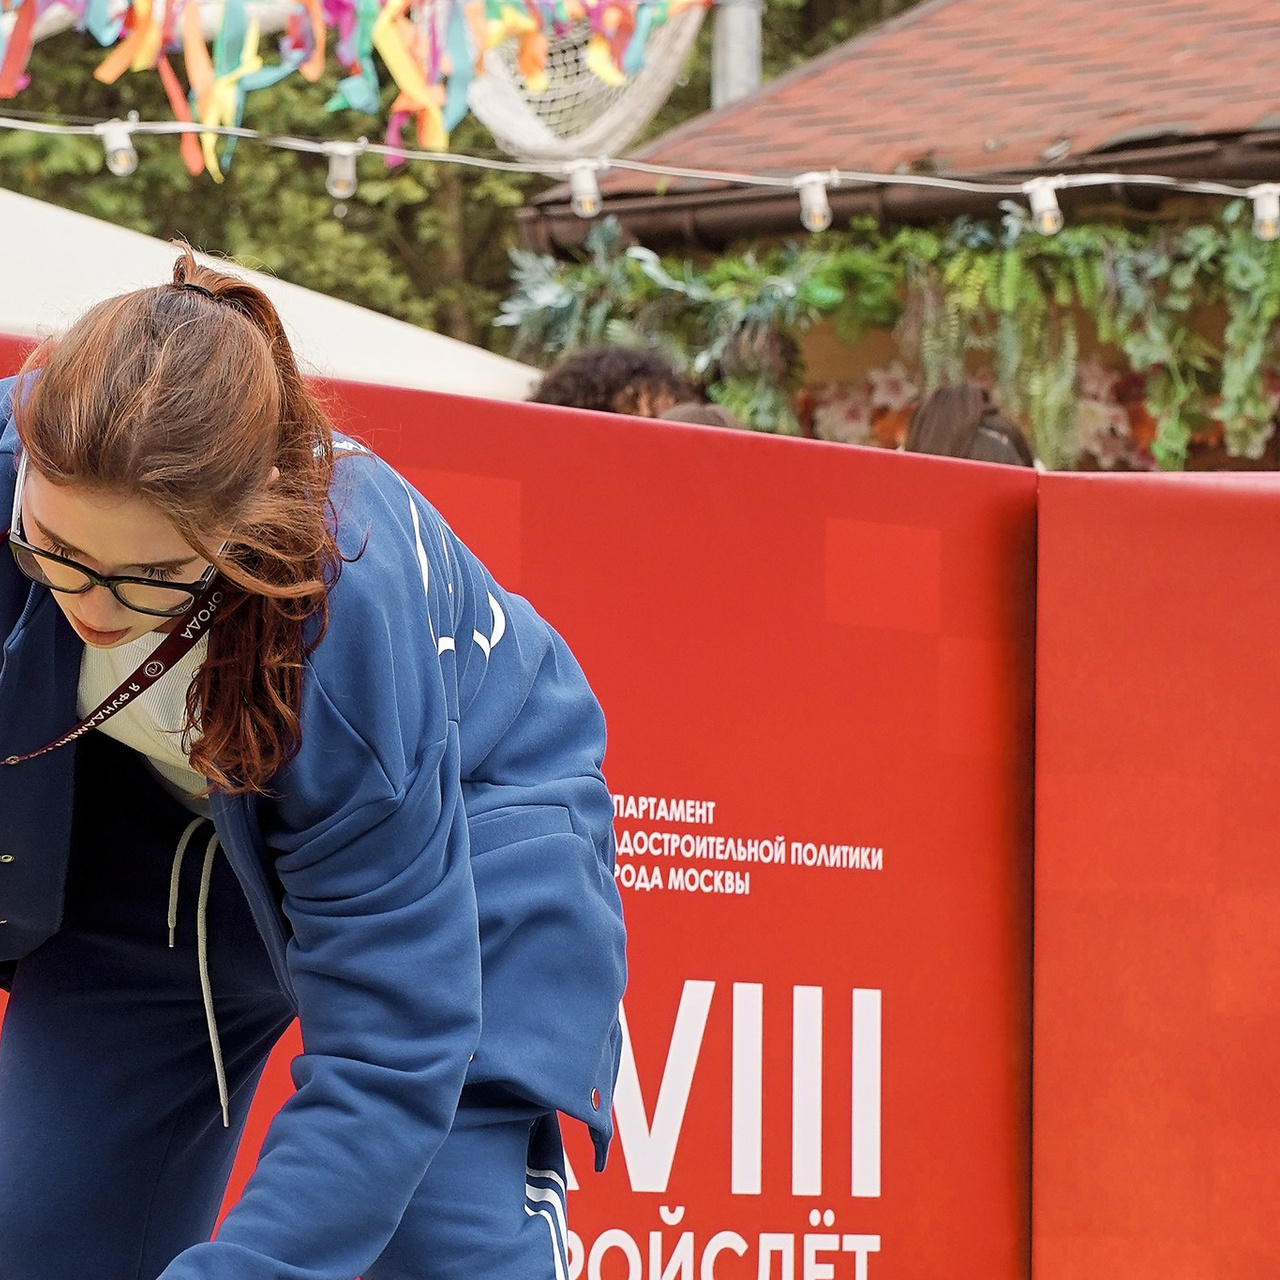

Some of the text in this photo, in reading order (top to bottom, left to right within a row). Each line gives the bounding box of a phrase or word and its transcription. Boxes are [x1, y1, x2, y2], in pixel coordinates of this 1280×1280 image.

[180, 591, 223, 639] ОРОДА
[128, 682, 141, 692] Я
[611, 793, 716, 824] ПАРТАМЕНТ
[614, 830, 884, 871] ДОСТРОИТЕЛЬНОЙ ПОЛИТИКИ
[667, 866, 751, 896] МОСКВЫ
[566, 979, 882, 1198] VIII
